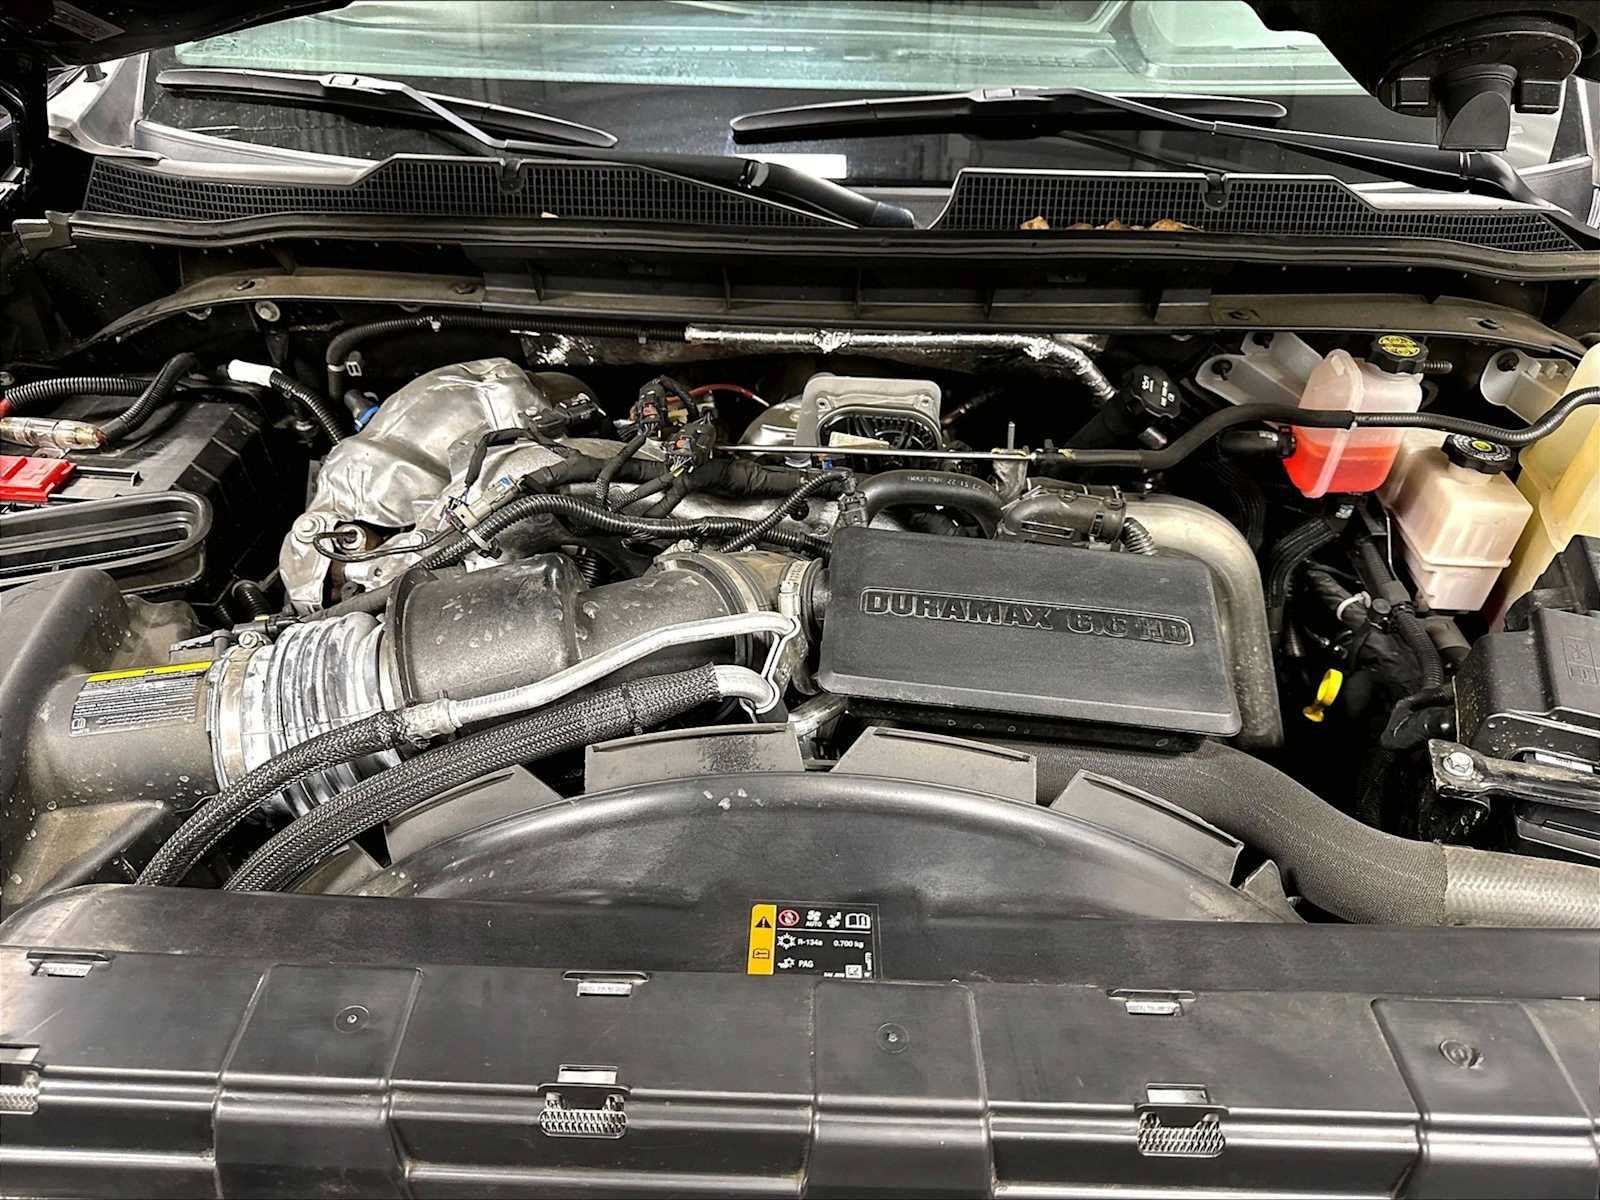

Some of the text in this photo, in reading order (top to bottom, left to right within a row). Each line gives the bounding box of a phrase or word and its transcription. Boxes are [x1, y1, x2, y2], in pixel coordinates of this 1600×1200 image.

[863, 590, 1054, 630] DURAMAX
[1066, 611, 1128, 637] 6.6
[833, 940, 853, 948] 0.700
[854, 940, 864, 949] kg
[798, 959, 814, 968] PAG
